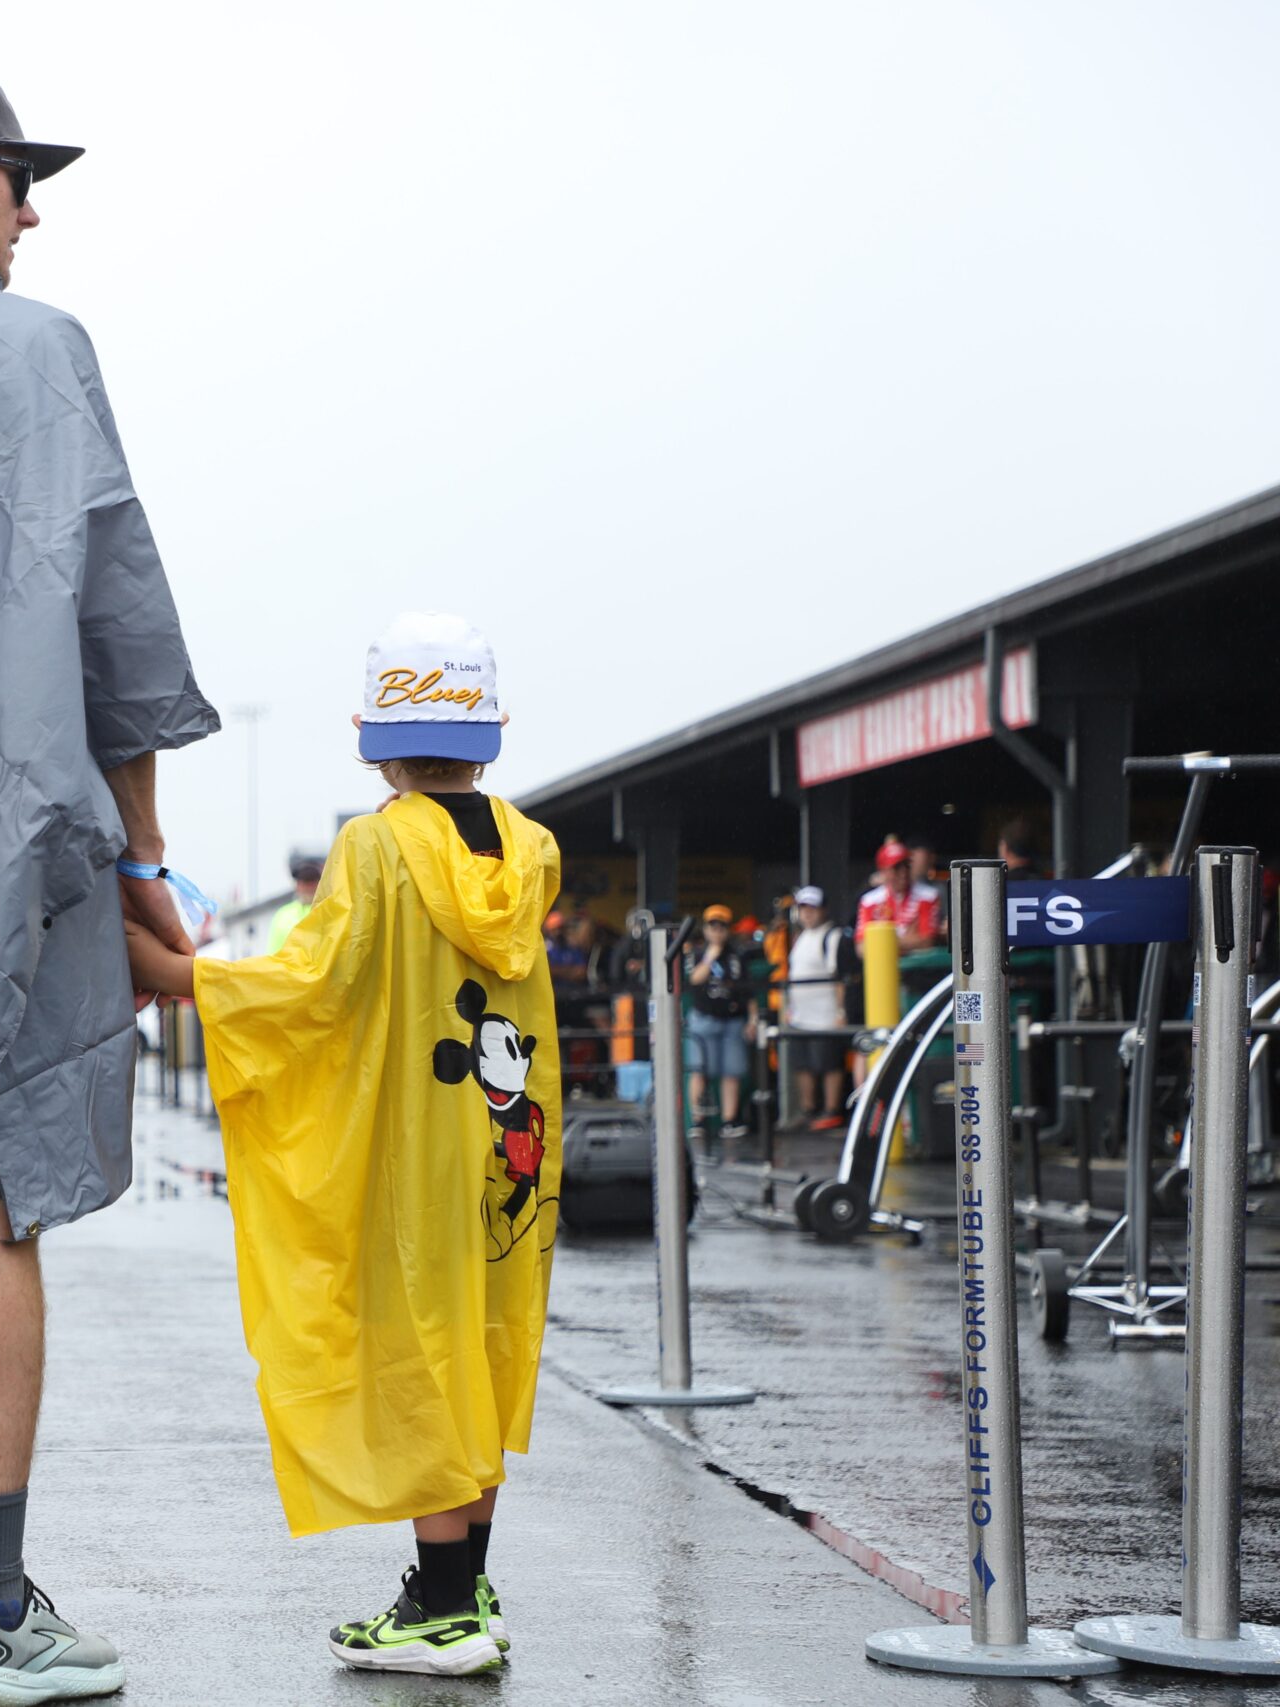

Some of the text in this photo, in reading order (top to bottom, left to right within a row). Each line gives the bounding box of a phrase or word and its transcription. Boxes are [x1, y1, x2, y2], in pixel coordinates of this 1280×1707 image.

[444, 662, 481, 673] St. Louis
[376, 668, 483, 711] Blues
[928, 670, 976, 747] PASS
[1007, 895, 1083, 936] FS
[961, 1085, 980, 1126] 304
[961, 1134, 981, 1163] SS
[968, 1386, 992, 1527] CLIFFS
